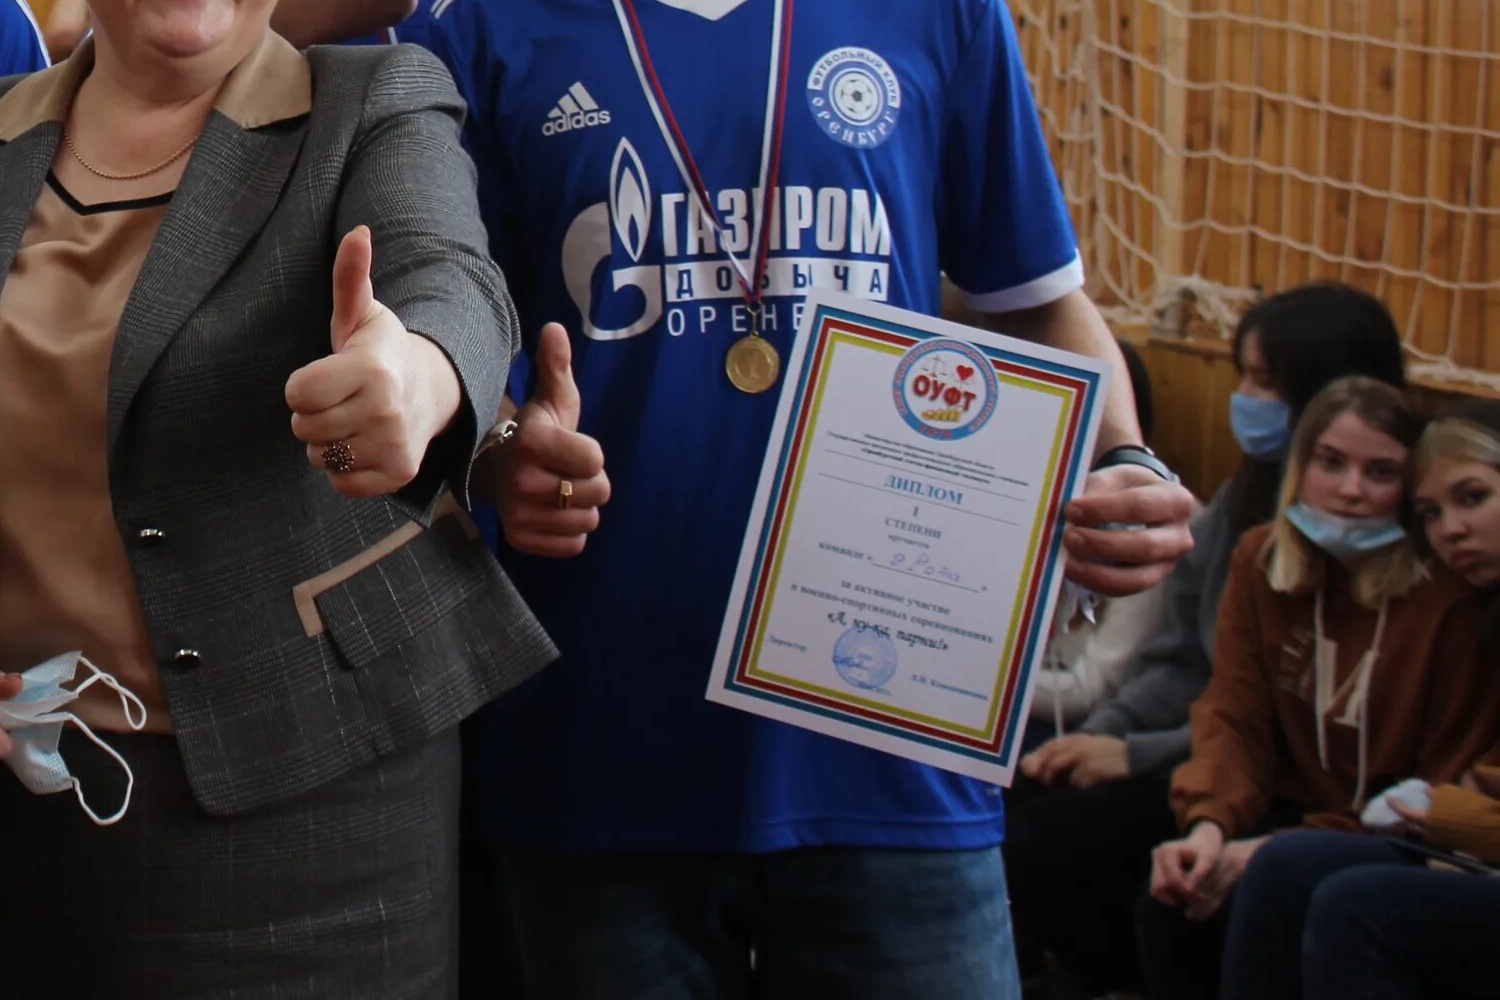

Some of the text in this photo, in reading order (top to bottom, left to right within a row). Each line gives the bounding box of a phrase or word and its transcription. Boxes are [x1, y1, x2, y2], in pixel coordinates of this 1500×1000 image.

[813, 51, 898, 103] ФУТБОЛЬНЫЙ КЛУБ
[542, 110, 611, 136] adidas
[812, 97, 894, 145] ОРЕНБУРГ
[661, 186, 891, 257] ГАЗПРОМ
[912, 374, 977, 412] ОУФТ
[883, 474, 963, 505] ДИПЛОМ
[884, 517, 941, 539] СТЕПЕНИ
[906, 598, 950, 617] участие
